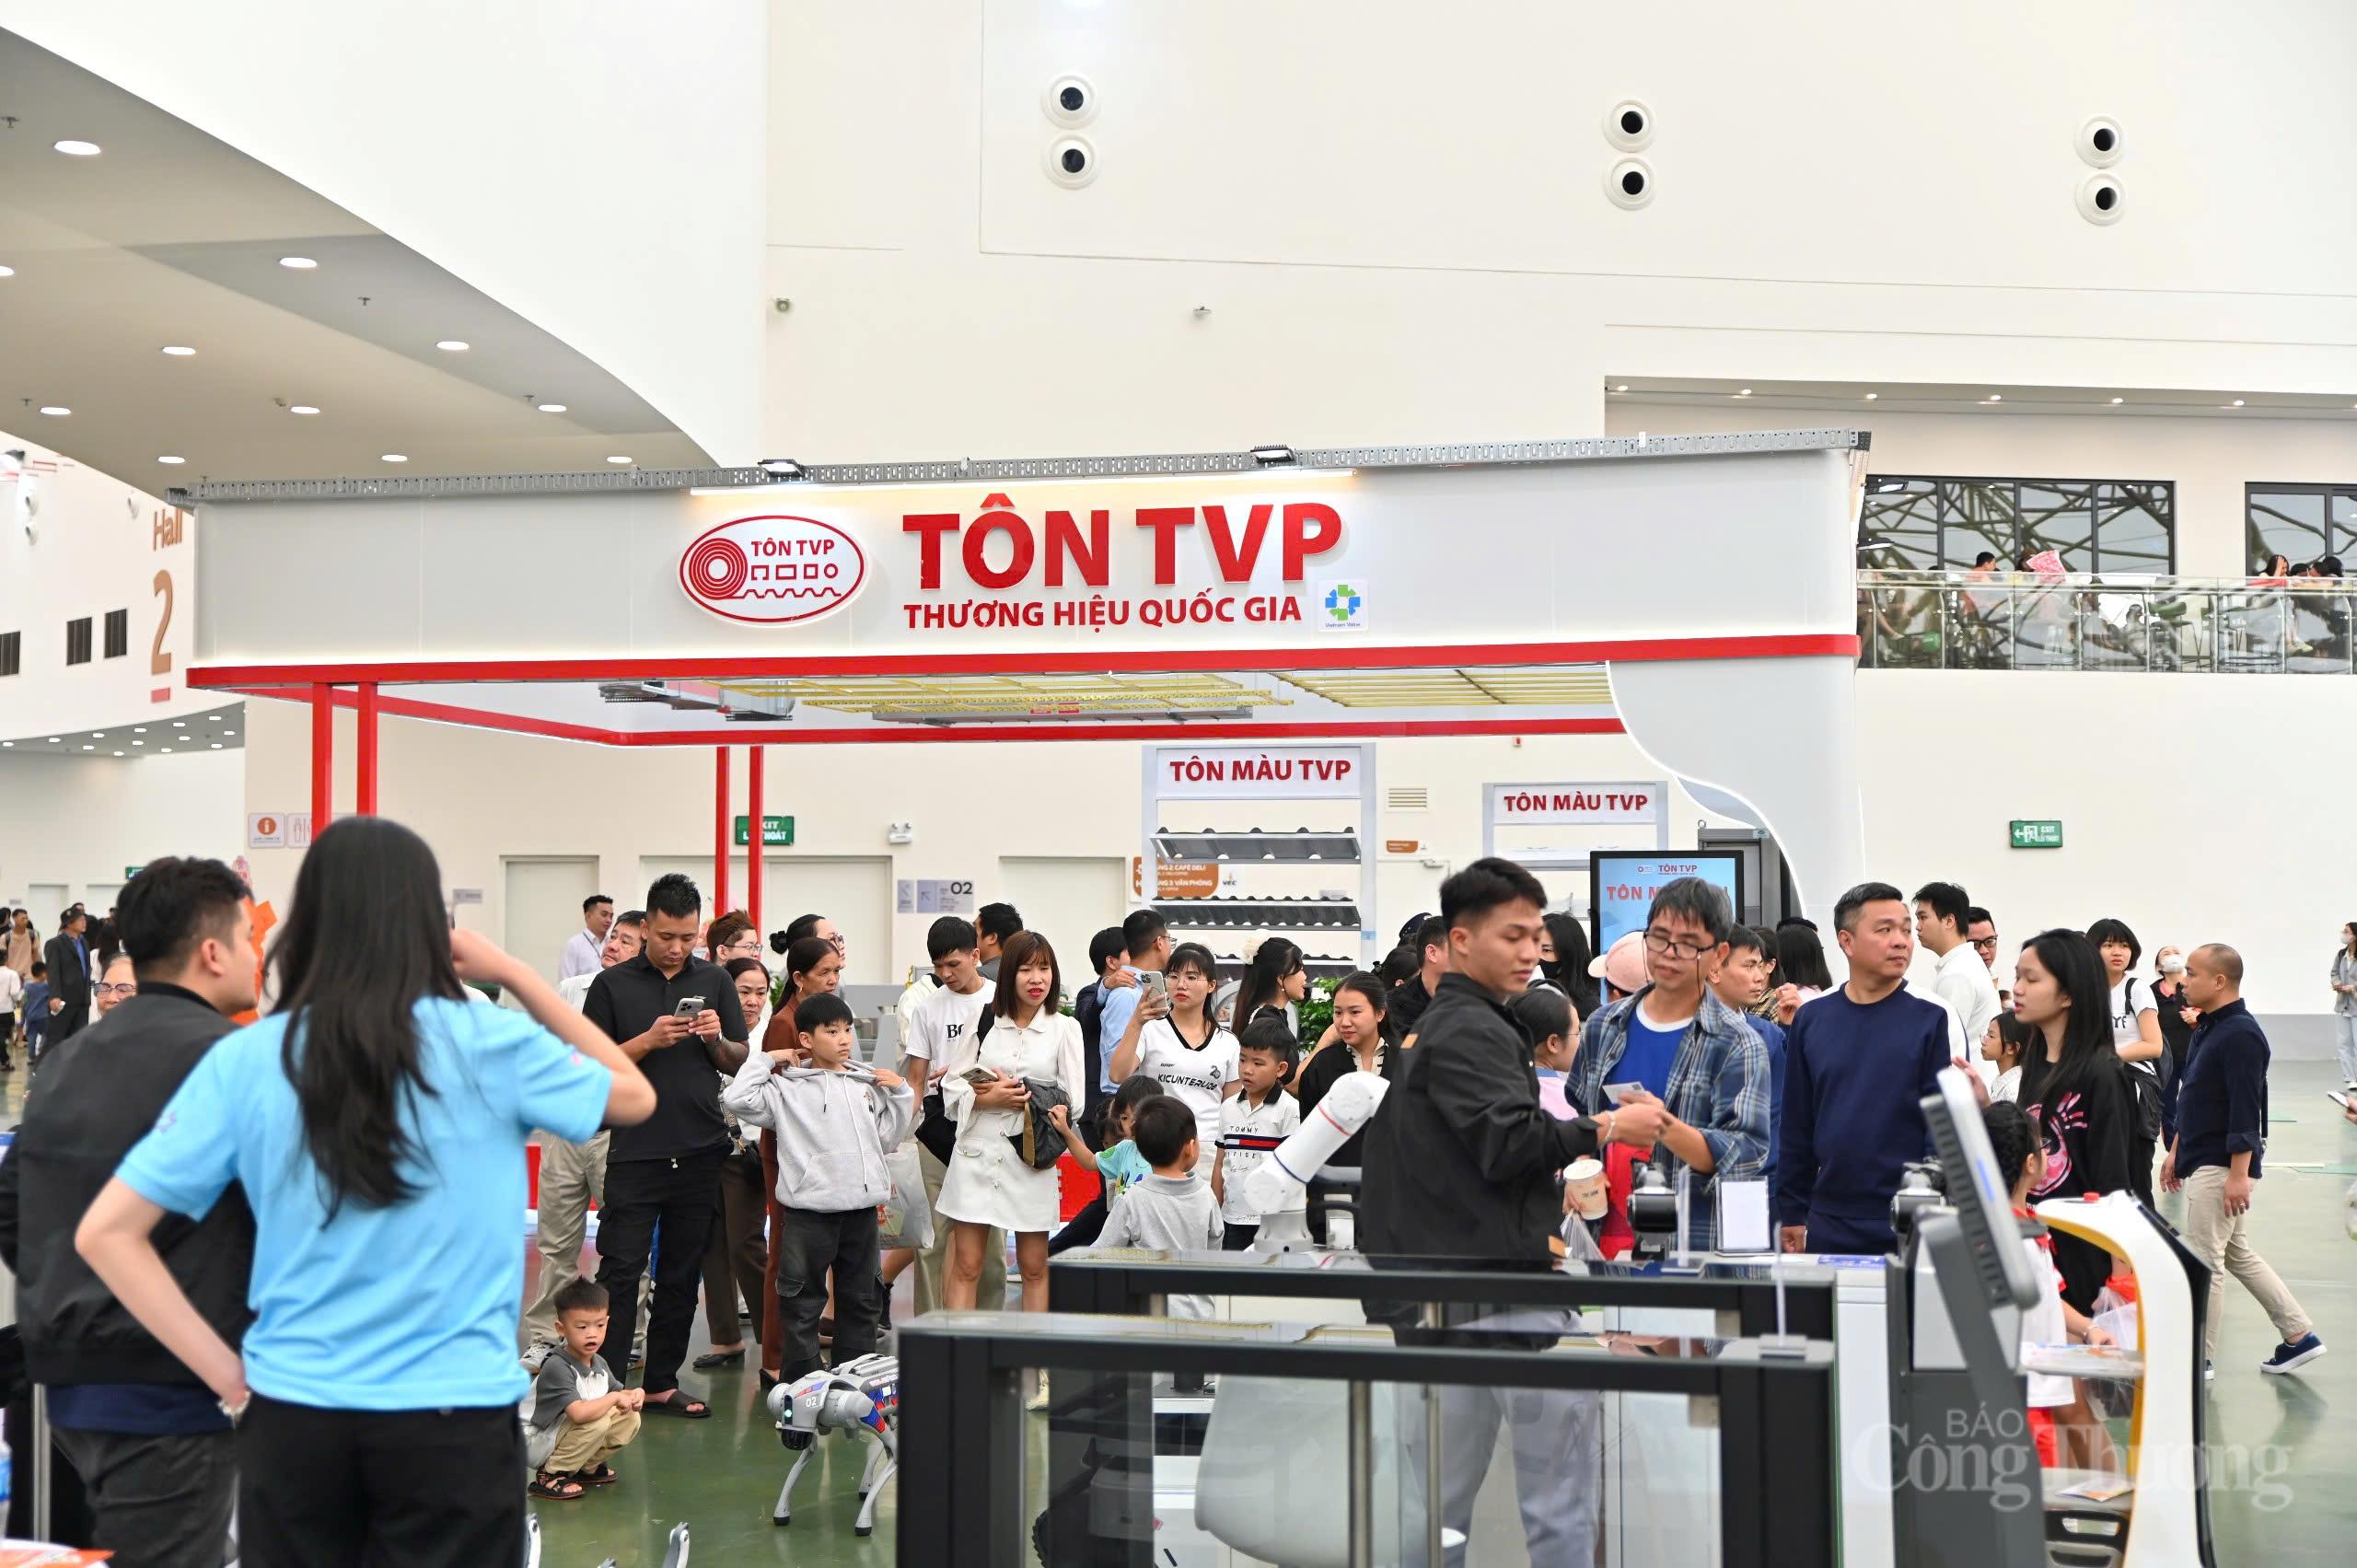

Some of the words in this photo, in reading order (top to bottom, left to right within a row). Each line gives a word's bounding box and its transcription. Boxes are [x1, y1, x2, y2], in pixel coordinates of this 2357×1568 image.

[153, 508, 182, 551] Hall
[751, 538, 792, 556] TÔN
[796, 540, 835, 555] TVP
[902, 493, 1109, 589] TÔN
[1135, 503, 1342, 584] TVP
[903, 599, 1044, 629] THƯƠNG
[1054, 594, 1130, 633] HIỆU
[1139, 588, 1235, 628] QUỐC
[1244, 596, 1302, 621] GIA
[151, 570, 173, 675] 2
[1170, 755, 1224, 781] TÔN
[1232, 754, 1292, 781] MÀU
[1298, 760, 1352, 780] TVP
[1504, 792, 1547, 811] TÔN
[1553, 791, 1601, 810] MÀU
[1606, 795, 1648, 810] TVP
[762, 821, 780, 830] XIT
[1658, 864, 1677, 872] TÔN
[950, 881, 973, 895] 02
[1606, 884, 1643, 900] TÔN
[1230, 1125, 1259, 1133] TOMMY
[806, 1396, 818, 1407] 02
